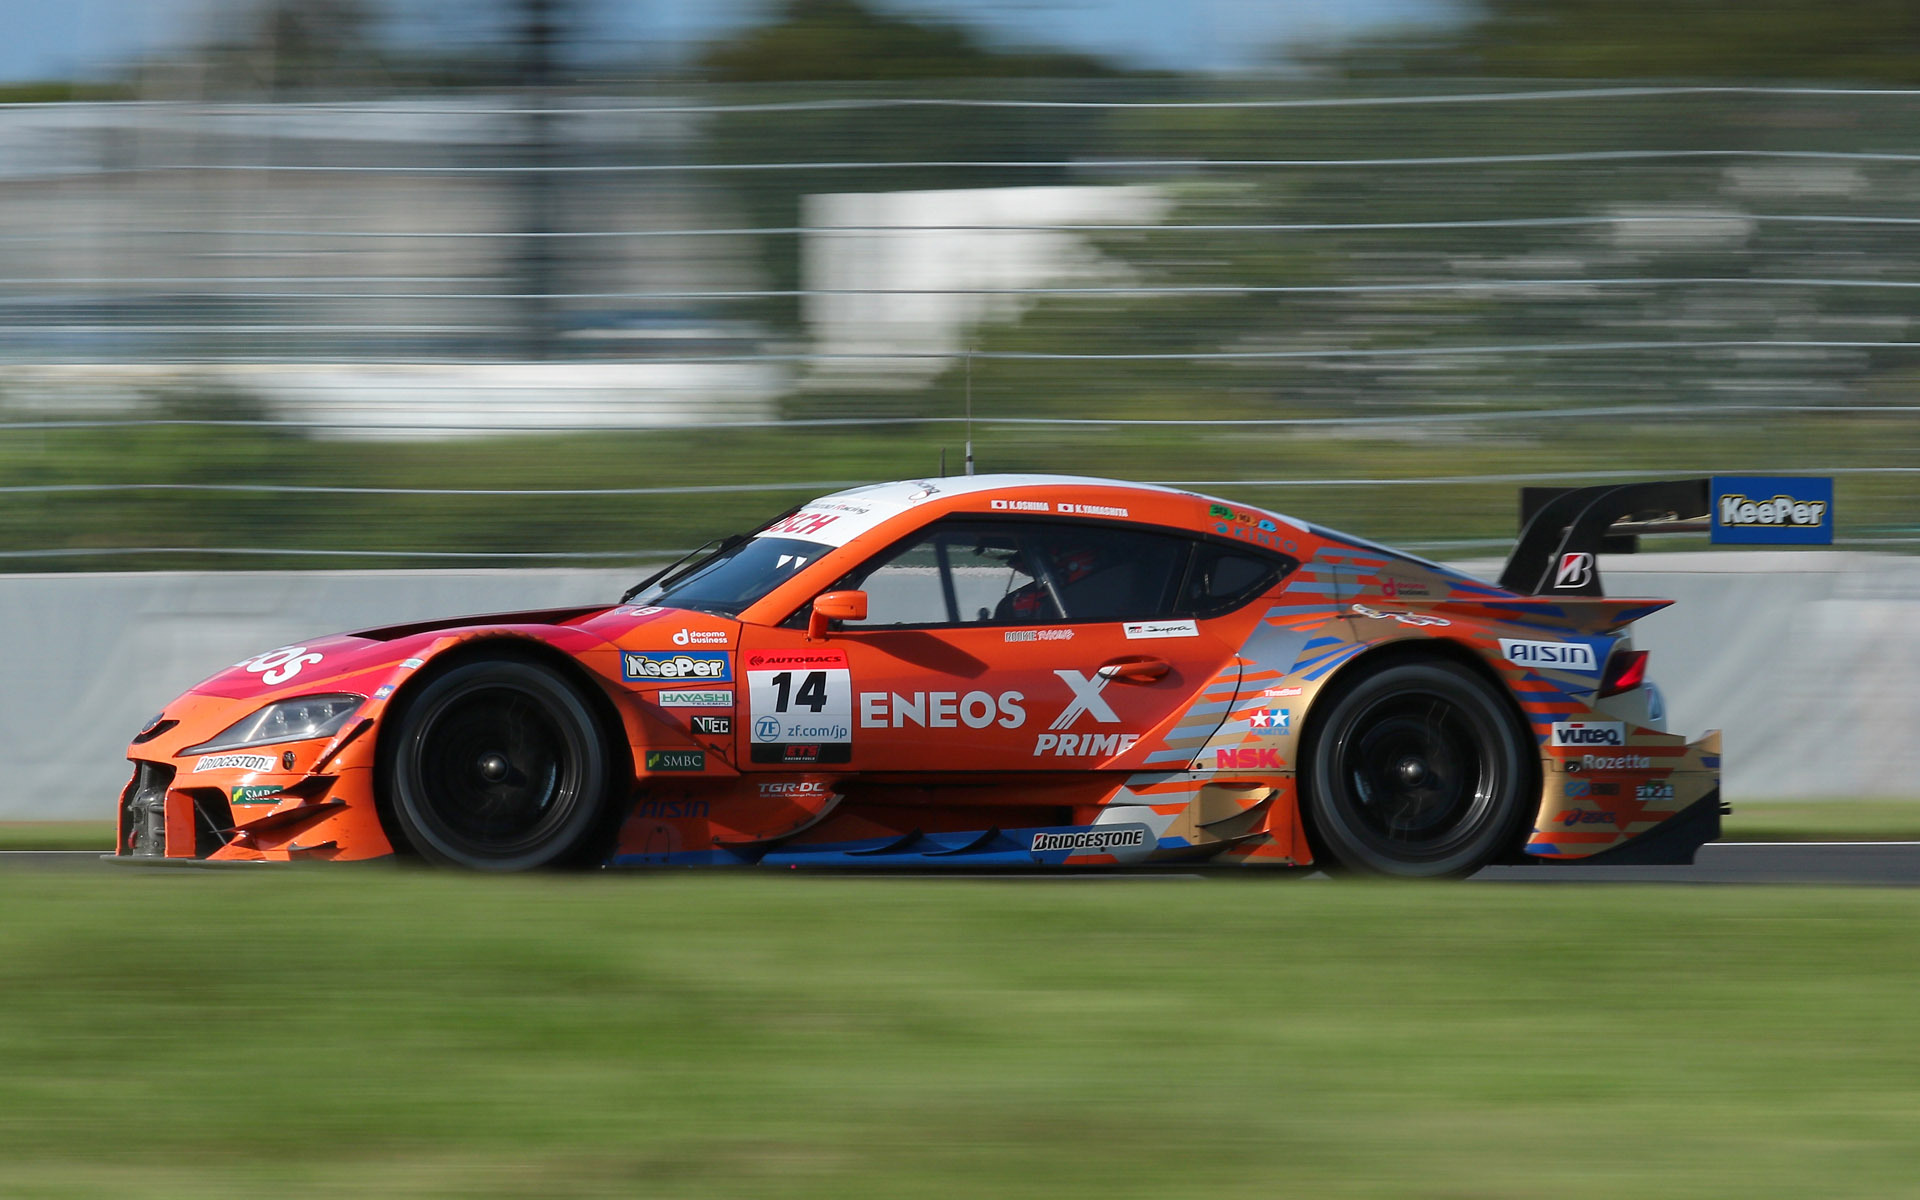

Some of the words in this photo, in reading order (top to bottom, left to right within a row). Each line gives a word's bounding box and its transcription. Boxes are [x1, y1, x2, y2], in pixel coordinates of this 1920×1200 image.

[1720, 494, 1826, 527] KeePer
[766, 656, 842, 664] AUTOBACS
[1510, 644, 1589, 664] AISIN
[625, 654, 724, 678] KeePer
[662, 693, 731, 703] HAYASHI
[772, 671, 828, 713] 14
[859, 690, 1026, 729] ENEOS
[788, 725, 848, 739] zf.com/jp
[1032, 733, 1140, 757] PRIME
[663, 755, 702, 767] SMBC
[1216, 748, 1281, 769] NSK
[1582, 754, 1651, 769] Rozetta
[1031, 830, 1144, 850] BRIDGESTONE
